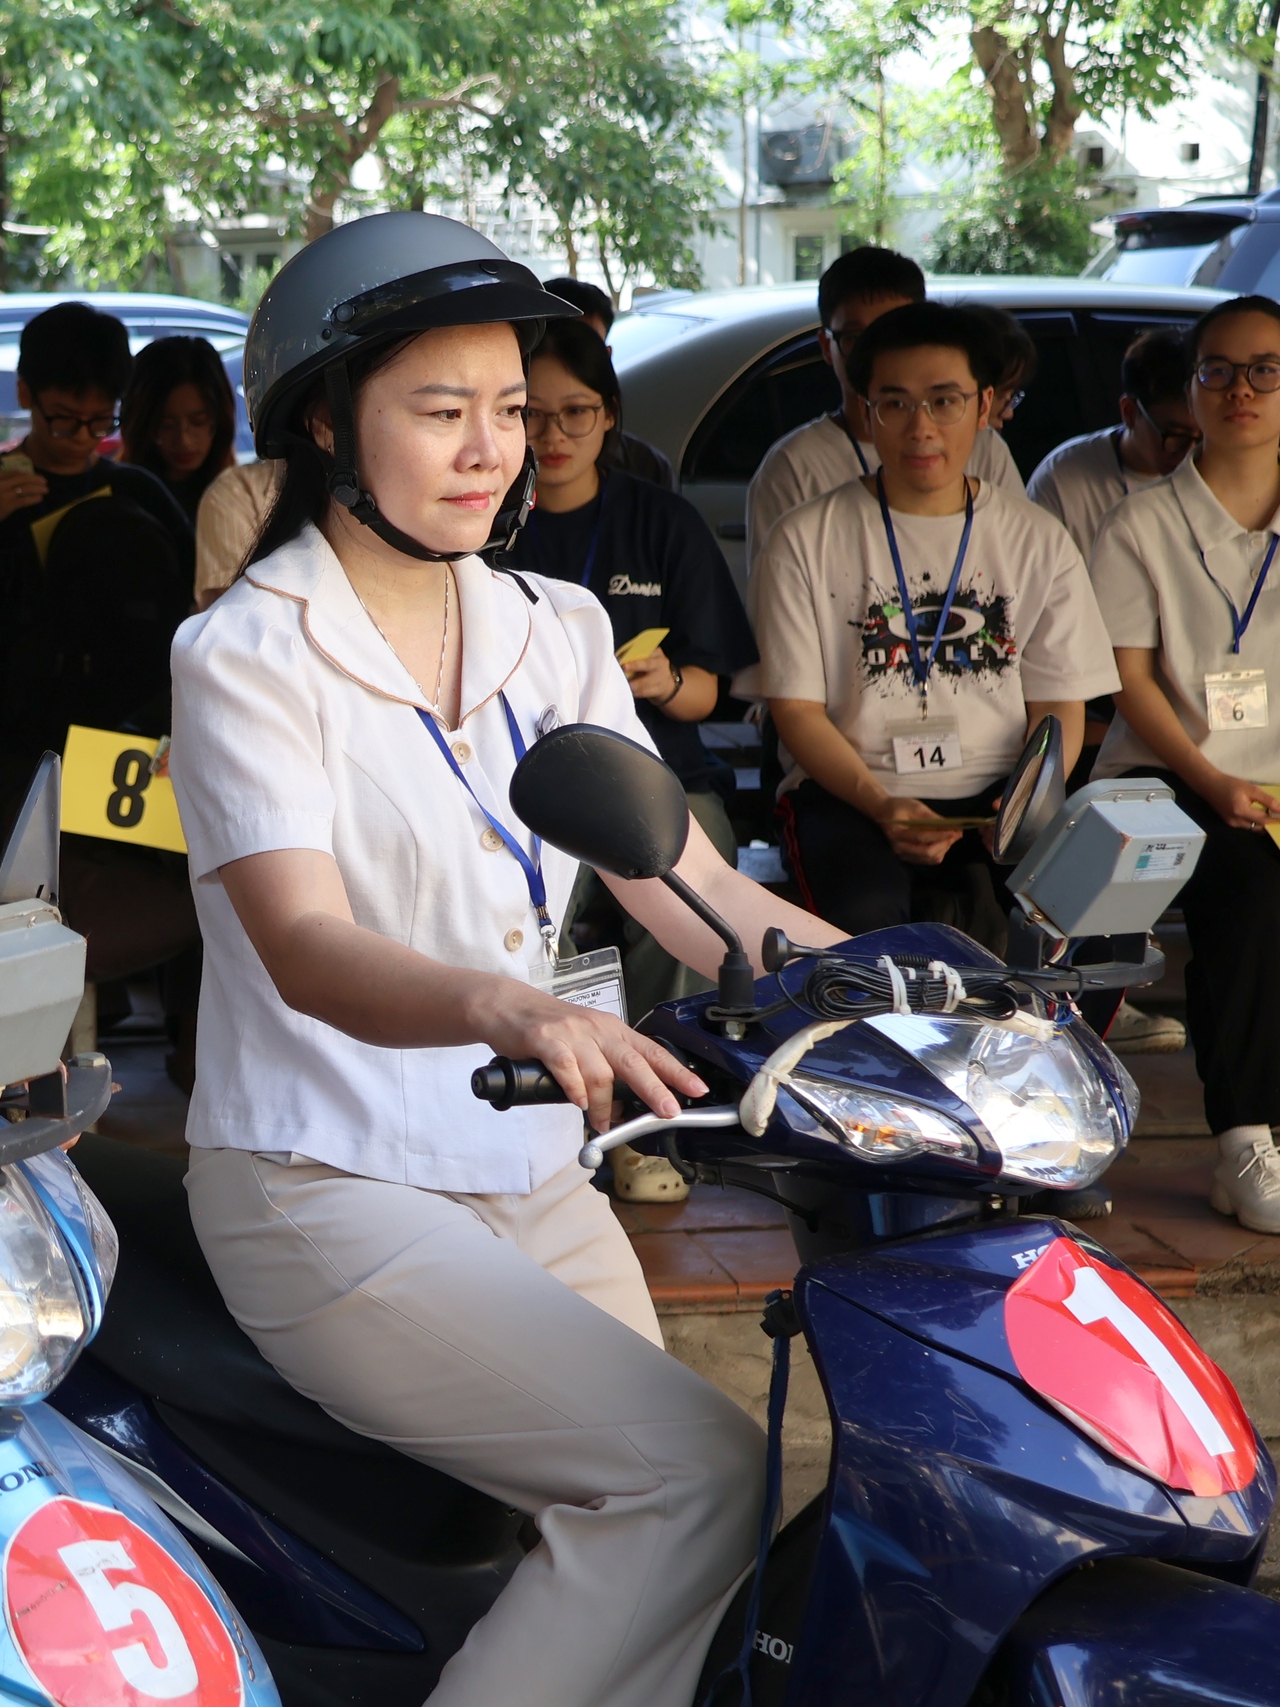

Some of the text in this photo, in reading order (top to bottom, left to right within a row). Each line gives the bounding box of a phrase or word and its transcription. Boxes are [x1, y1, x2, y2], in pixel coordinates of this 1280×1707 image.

[867, 642, 1011, 666] OAKLEY
[1233, 702, 1244, 722] 6
[913, 745, 946, 768] 14
[106, 748, 153, 828] 8
[1062, 1265, 1235, 1457] 1
[57, 1538, 199, 1699] 5
